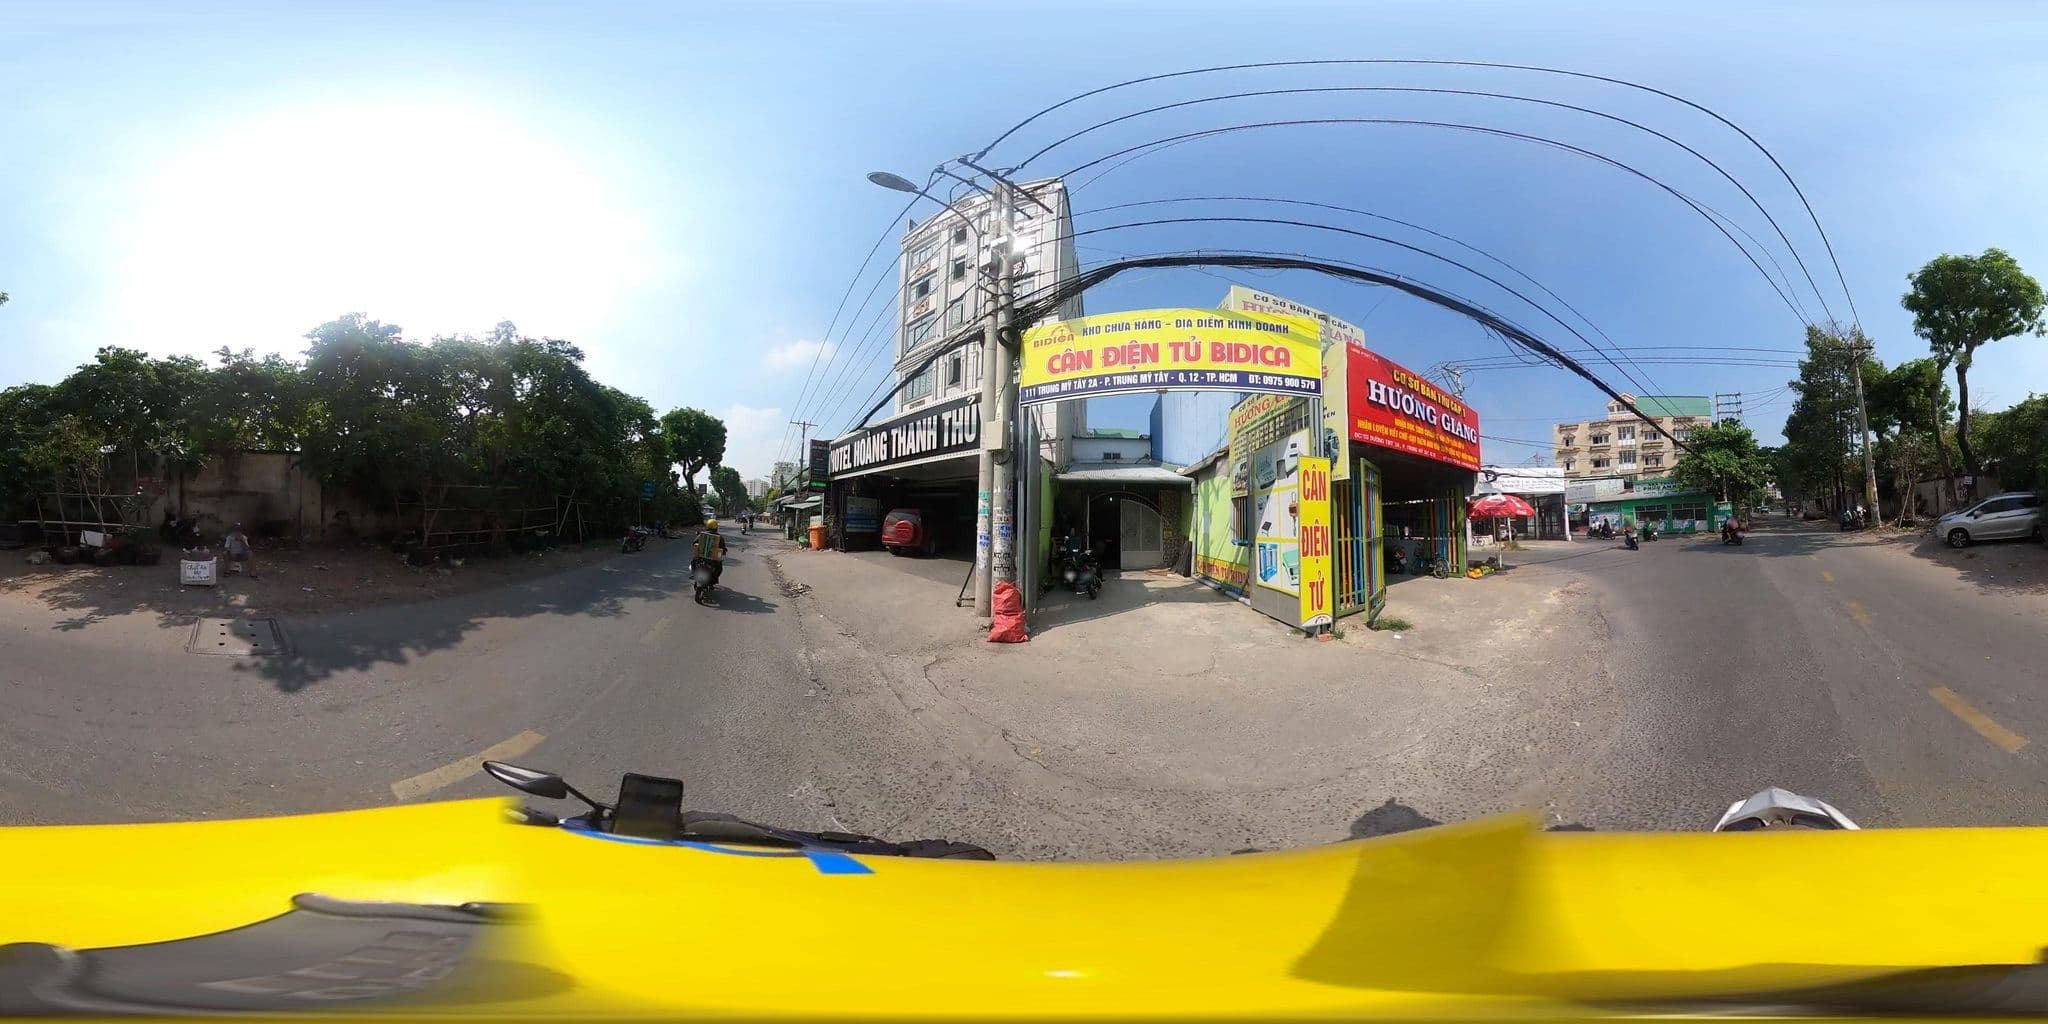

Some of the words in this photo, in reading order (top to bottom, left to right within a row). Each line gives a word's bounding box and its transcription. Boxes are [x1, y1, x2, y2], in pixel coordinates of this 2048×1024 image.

[1082, 325, 1101, 337] KHO
[1228, 319, 1252, 330] KINH
[1255, 321, 1289, 334] DOANH
[1047, 348, 1094, 375] CÂN
[1101, 340, 1159, 370] ĐIỆN
[1210, 341, 1291, 367] BIDICA
[1025, 388, 1036, 399] 111
[1038, 384, 1060, 396] TRUNG
[1061, 380, 1072, 392] MỸ
[1074, 378, 1086, 390] TÂY
[1088, 378, 1098, 388] 2A
[1104, 377, 1112, 386] P.
[1113, 374, 1138, 386] TRUNG
[1140, 371, 1153, 384] MỸ
[1154, 371, 1169, 383] TÂY
[1178, 373, 1187, 383] Q.
[1188, 372, 1198, 382] 12
[1206, 373, 1218, 382] TP.
[1219, 373, 1238, 383] HCM
[1263, 375, 1283, 386] 0975
[1284, 376, 1300, 388] 900
[1300, 378, 1316, 390] 579
[1367, 378, 1437, 426] HƯƠNG
[1441, 412, 1478, 444] GIANG
[853, 430, 888, 467] HOÀNG
[890, 414, 938, 460] THANH
[1302, 464, 1327, 502] CÂN
[1301, 519, 1329, 565] ĐIỆN
[1309, 570, 1325, 612] TỬ
